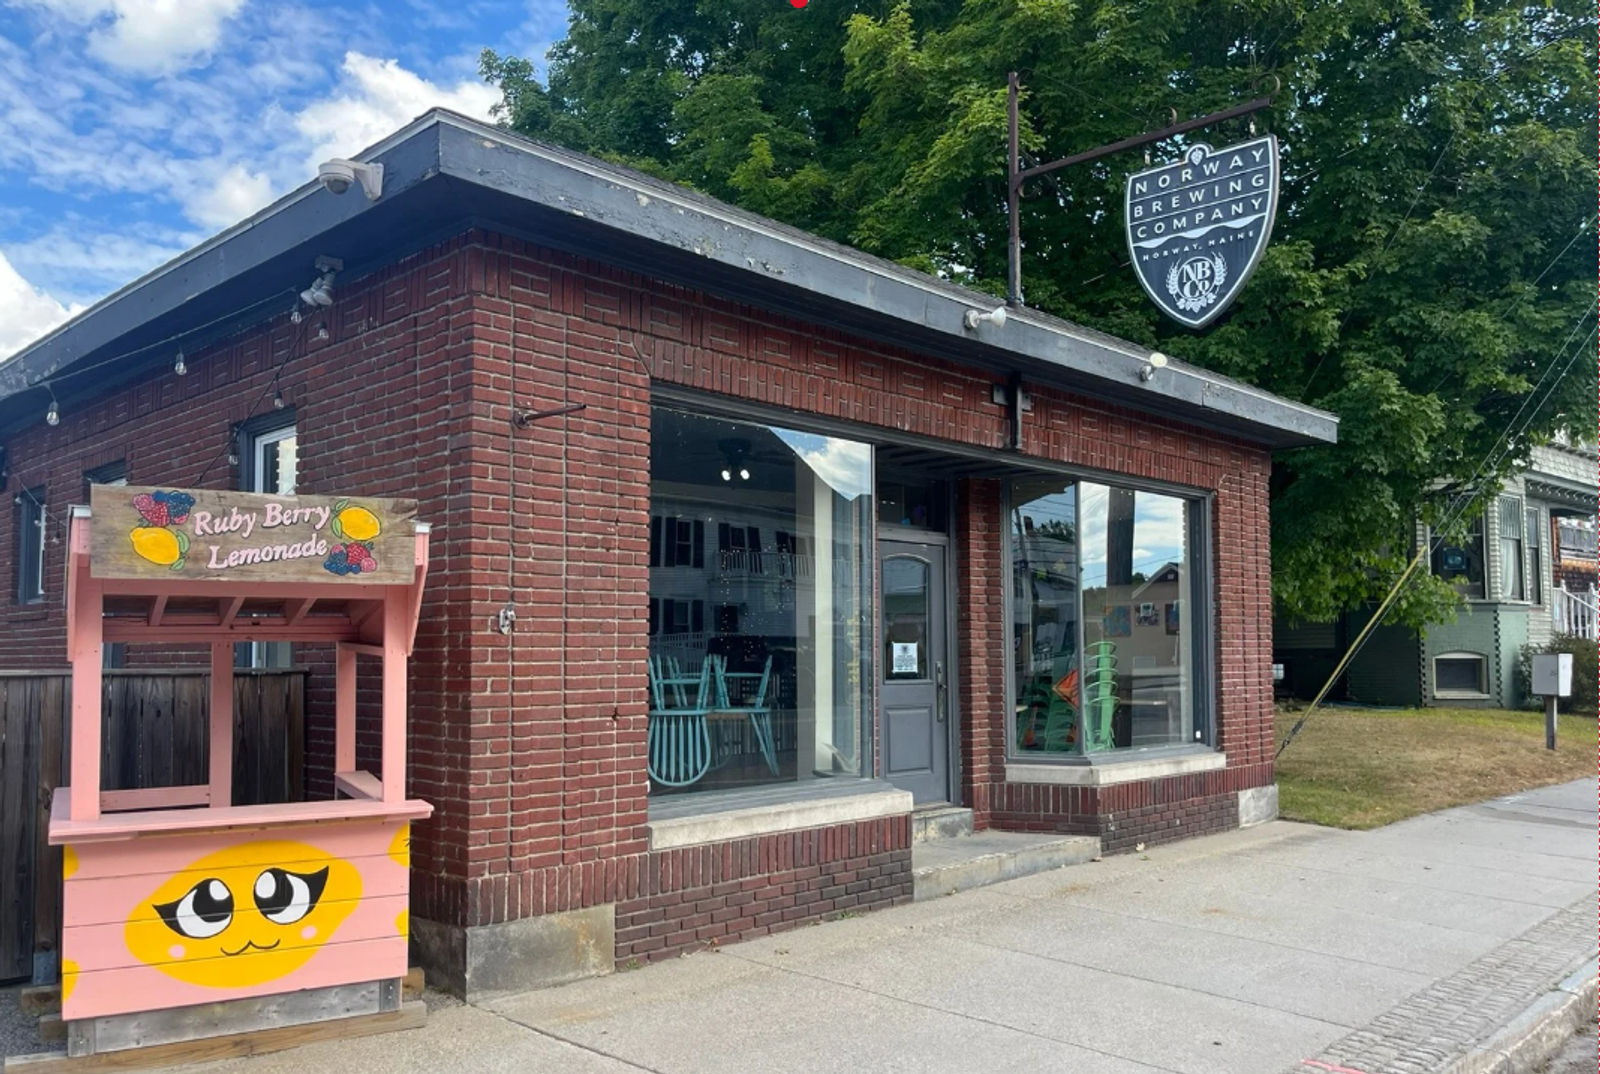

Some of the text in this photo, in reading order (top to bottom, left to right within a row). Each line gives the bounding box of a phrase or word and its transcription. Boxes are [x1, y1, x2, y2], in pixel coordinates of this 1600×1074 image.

[1135, 148, 1265, 195] NORWAY
[1134, 173, 1265, 217] BREWING
[1137, 197, 1263, 238] COMPANY
[1208, 230, 1254, 246] MAINE
[194, 502, 330, 537] Ruby Berry
[206, 533, 327, 570] Lemonade
